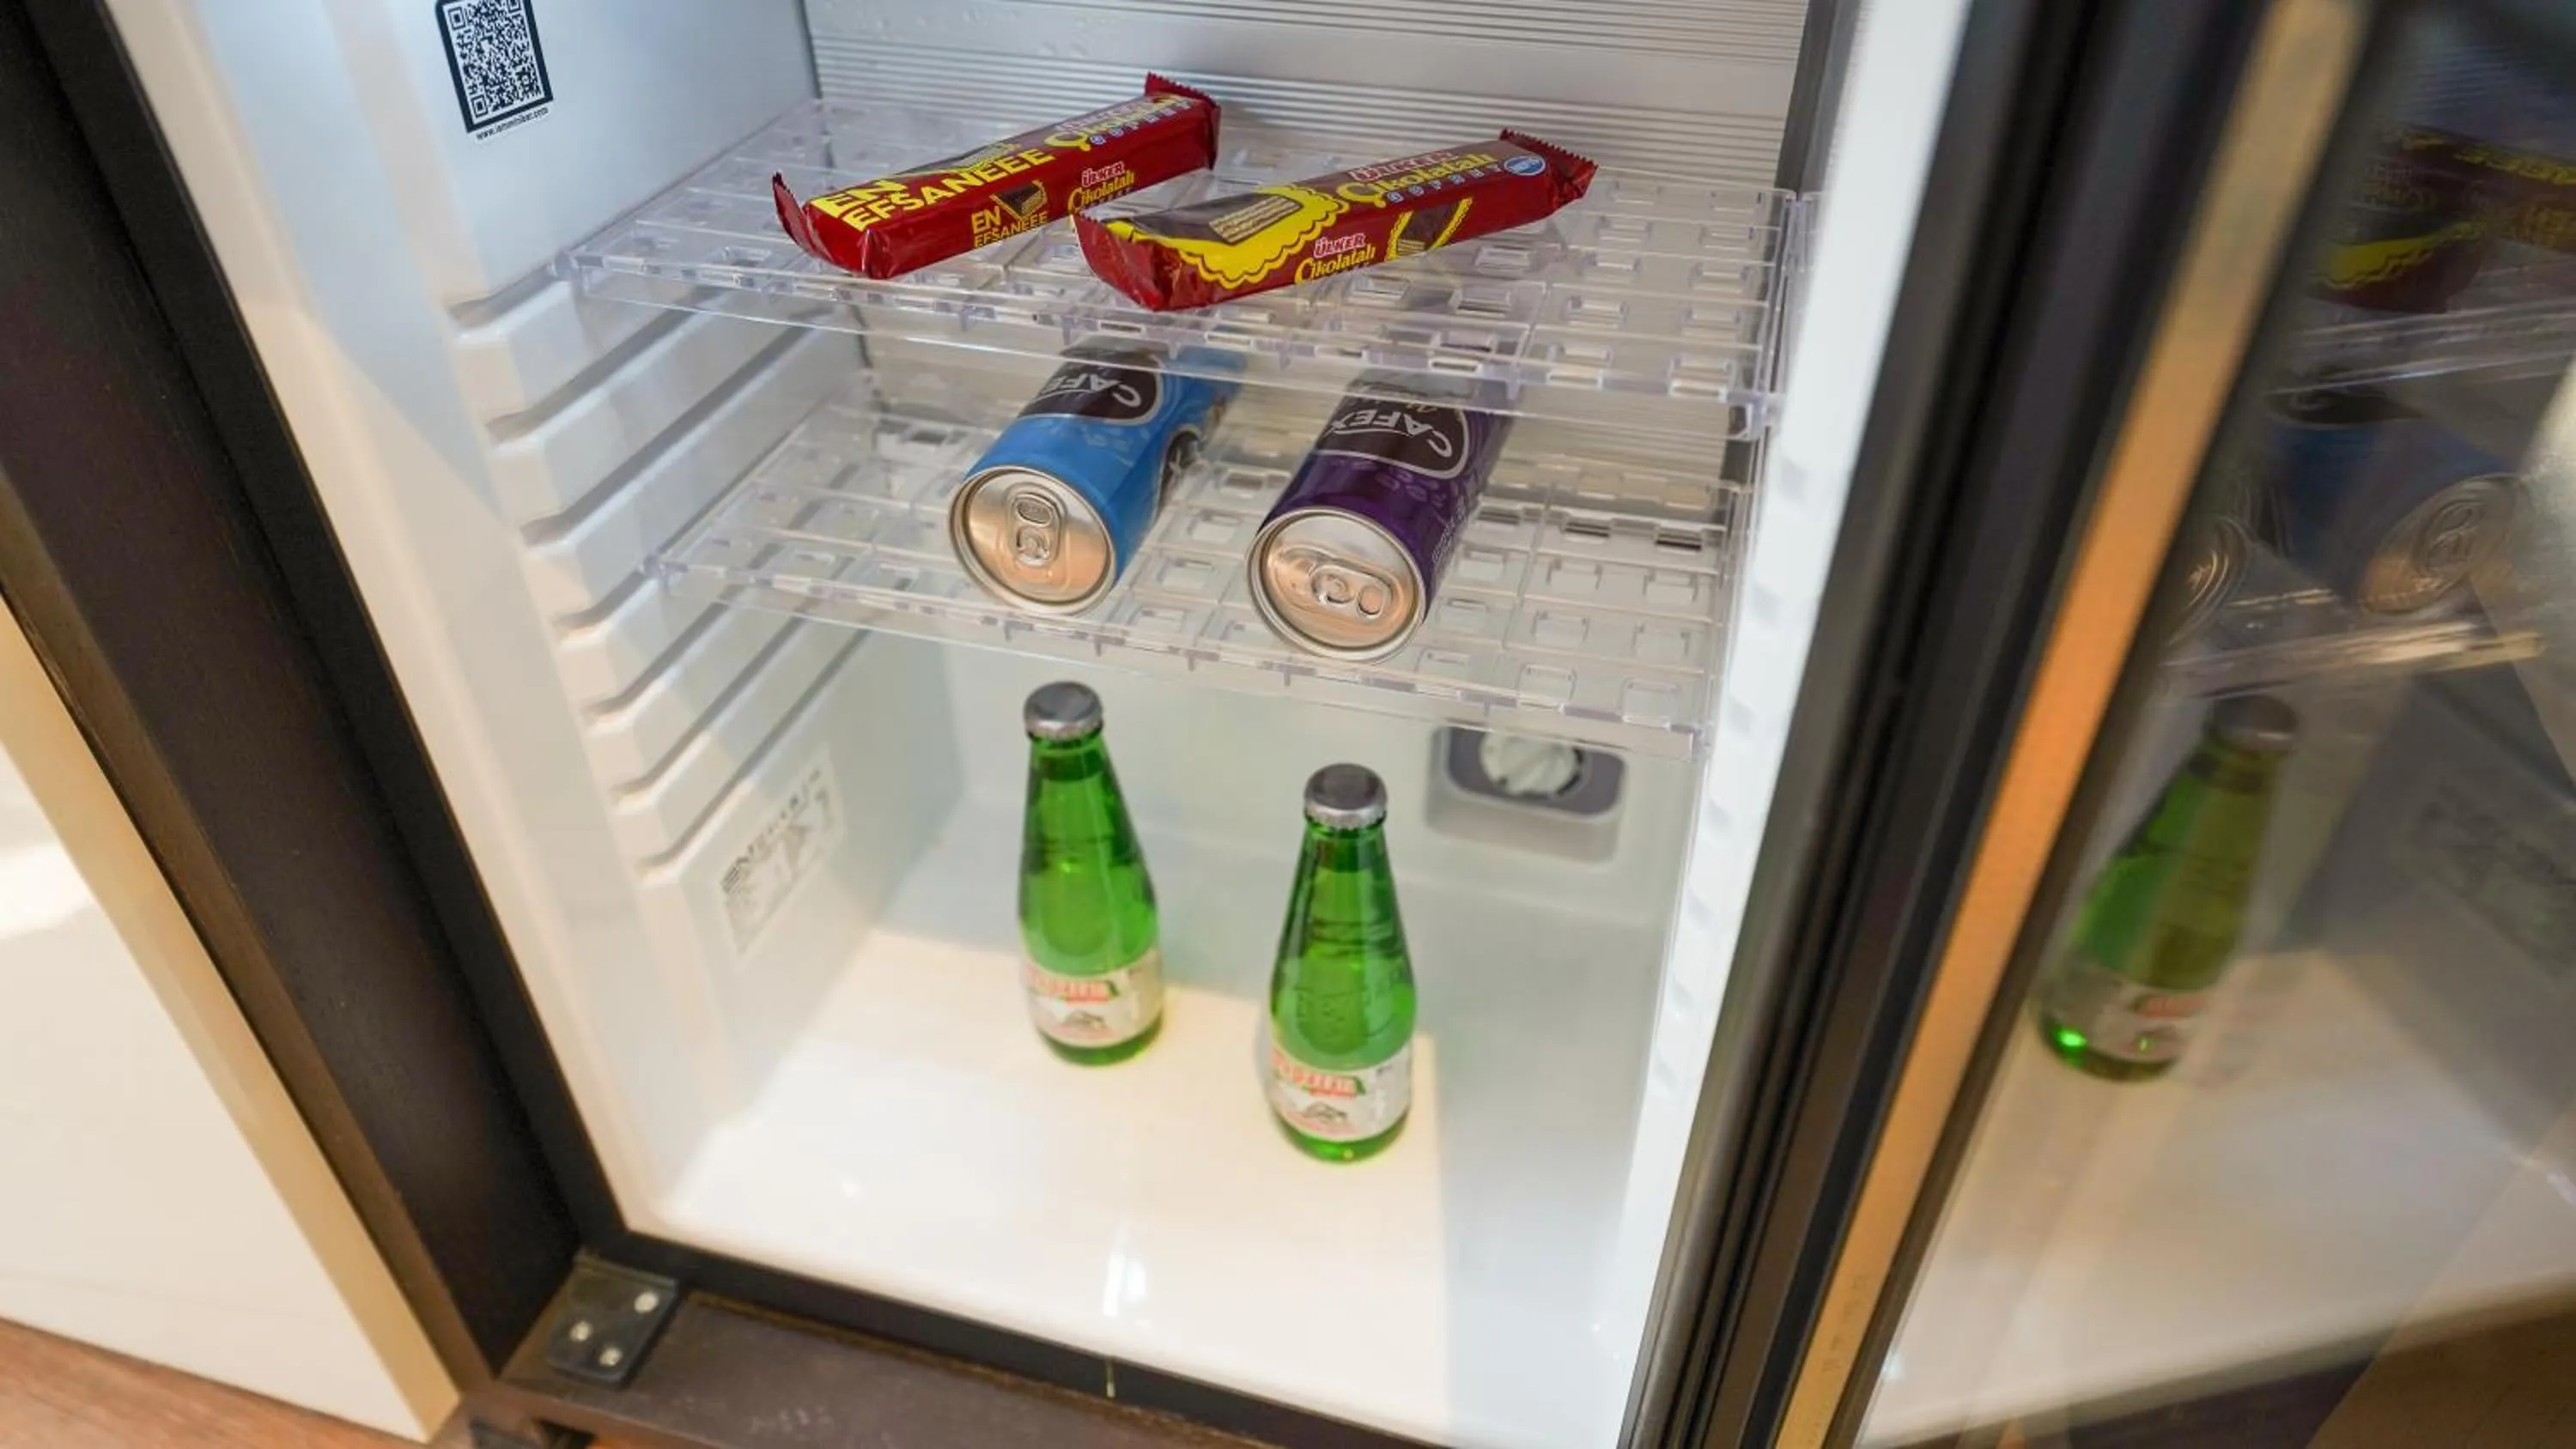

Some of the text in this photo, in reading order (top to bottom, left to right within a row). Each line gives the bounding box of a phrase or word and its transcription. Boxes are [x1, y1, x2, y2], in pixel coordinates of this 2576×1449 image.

[810, 179, 908, 219] EN
[841, 148, 1057, 233] EFSANEEE
[971, 205, 1001, 234] EN
[975, 210, 1048, 248] EFSANEEE
